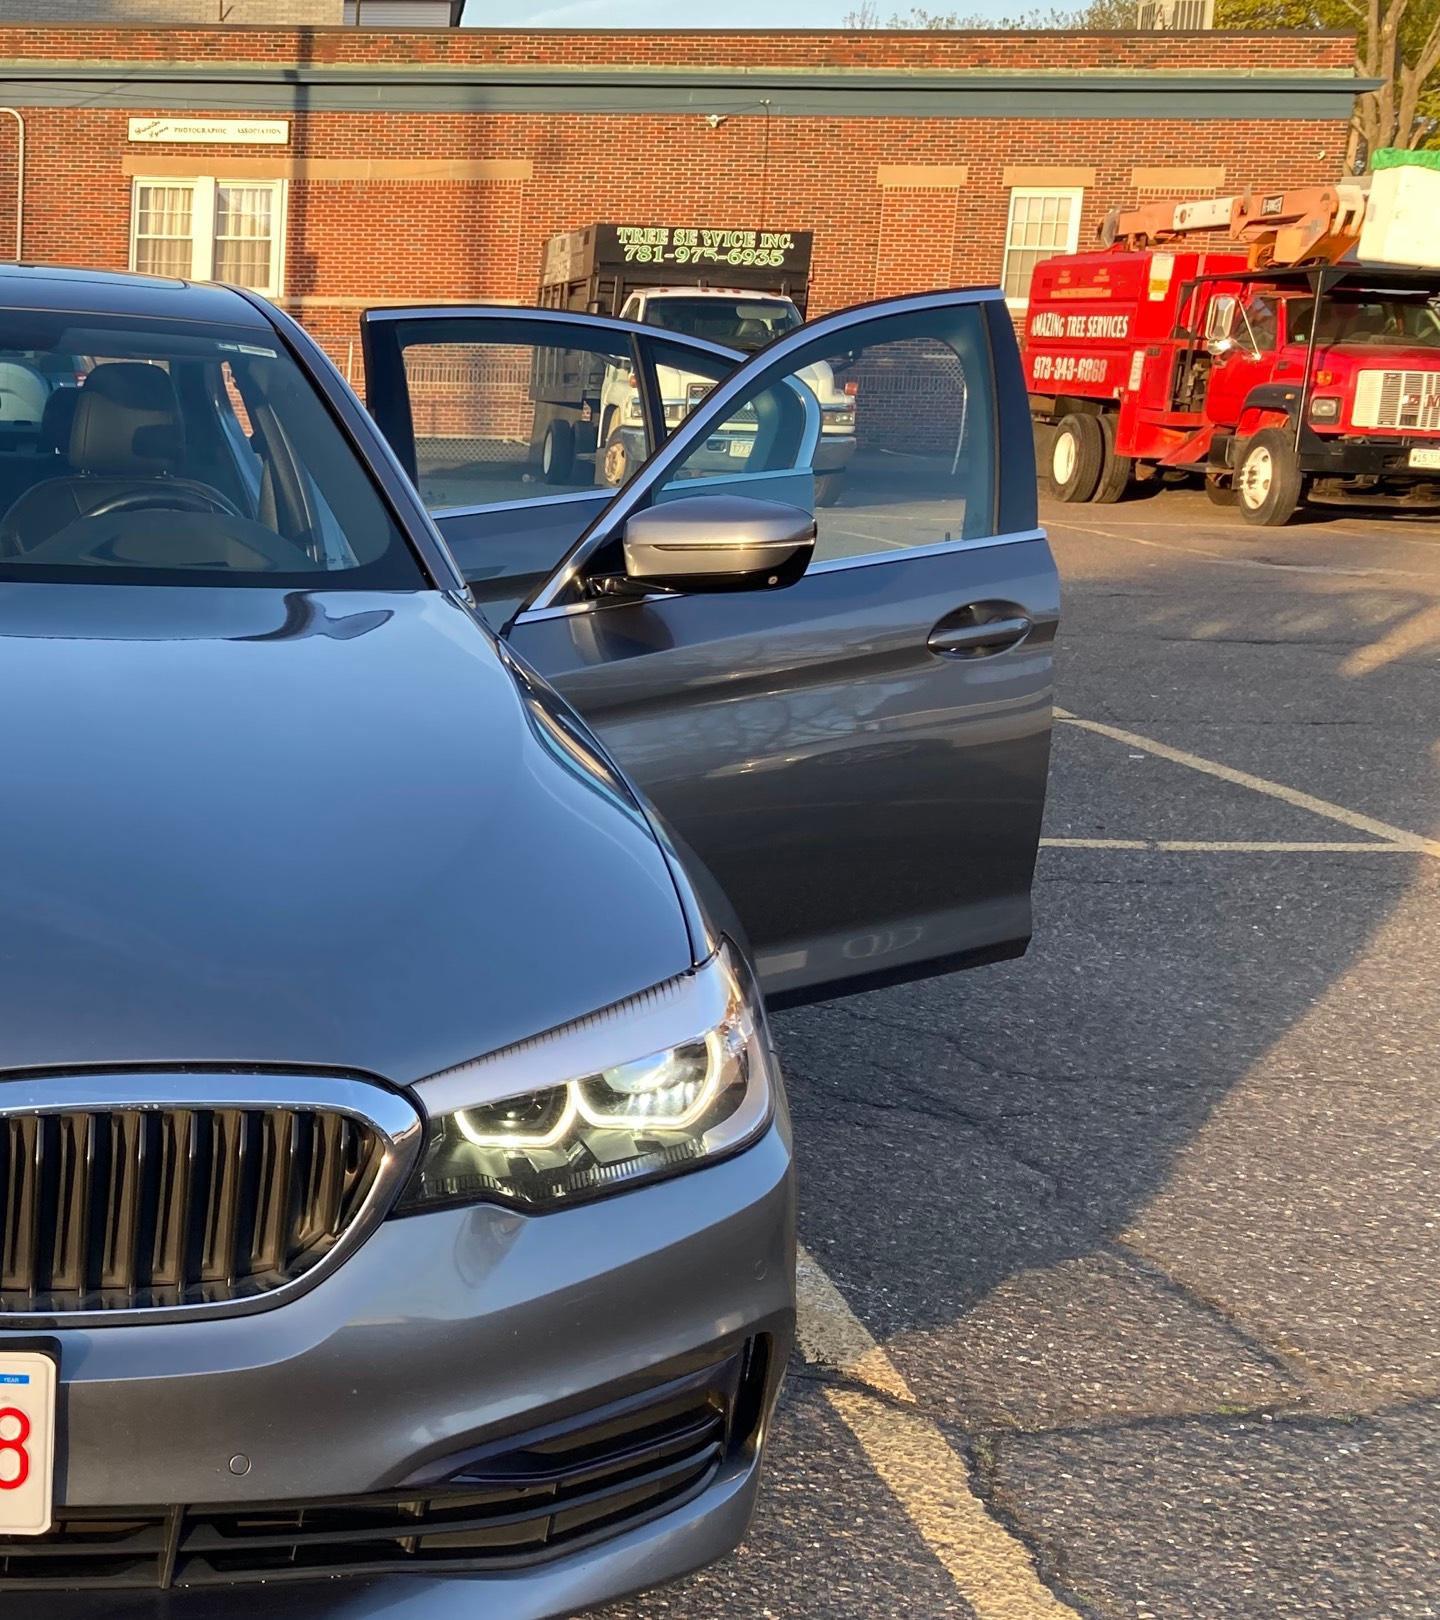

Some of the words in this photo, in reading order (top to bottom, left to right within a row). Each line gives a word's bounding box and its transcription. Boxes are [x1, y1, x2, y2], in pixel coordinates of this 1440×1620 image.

[237, 127, 281, 135] ASSOCIATION
[617, 226, 669, 245] TREE
[760, 233, 795, 249] INC.
[1066, 315, 1087, 337] TREE
[1086, 315, 1129, 338] SERVICES
